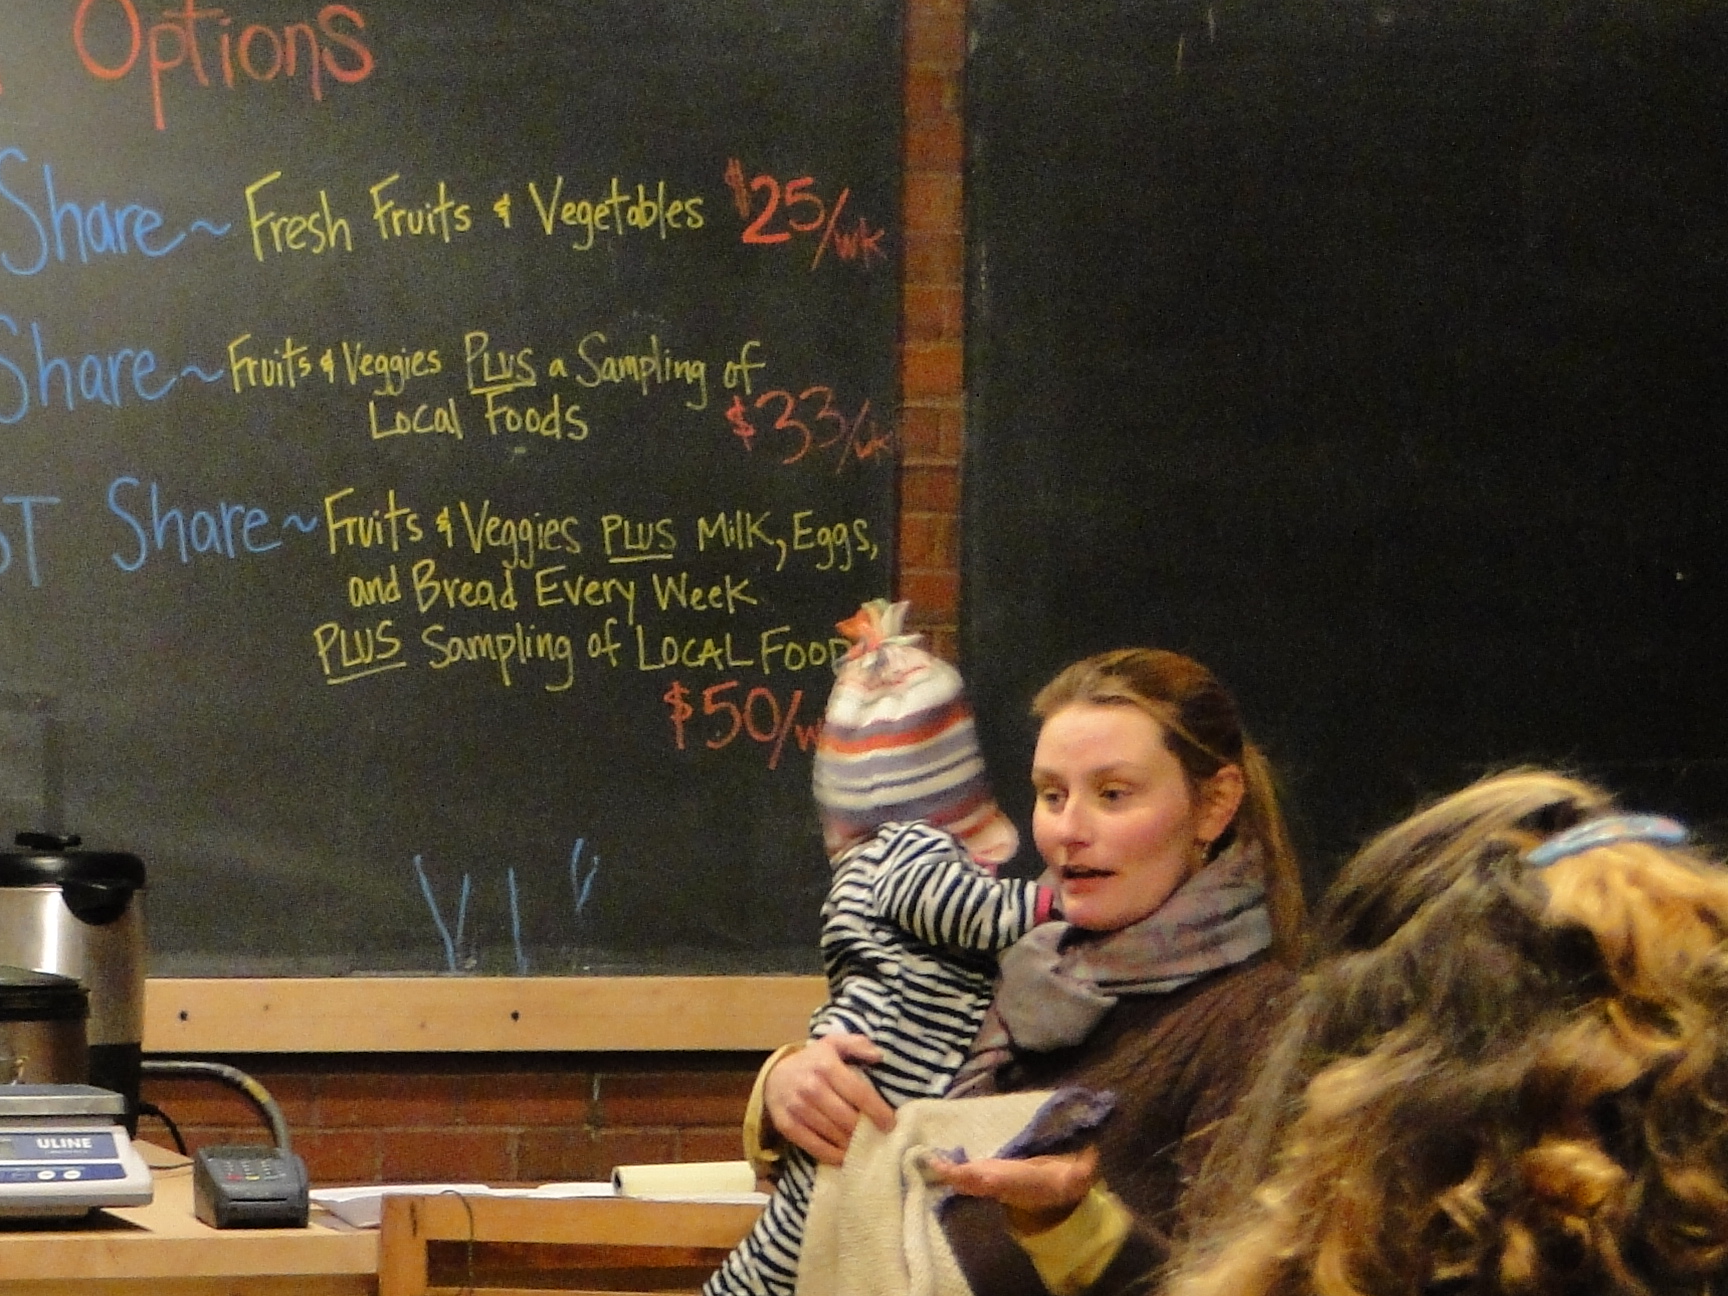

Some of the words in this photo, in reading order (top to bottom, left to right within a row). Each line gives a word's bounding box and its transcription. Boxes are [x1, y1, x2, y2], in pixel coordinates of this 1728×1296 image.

[73, 0, 373, 131] Options
[245, 170, 353, 261] Fresh
[370, 174, 472, 242] Fruits
[528, 176, 704, 250] Vegetables
[228, 334, 311, 393] Fruits
[342, 342, 442, 396] Veggies
[465, 331, 536, 384] PLUS
[549, 358, 568, 380] a
[577, 331, 708, 410] Sampling
[723, 340, 767, 395] of
[369, 400, 463, 440] Local
[484, 390, 589, 440] Foods
[324, 487, 423, 554] Fruits
[459, 500, 579, 569] Veggies
[602, 515, 676, 551] PLUS
[349, 566, 400, 610] and
[412, 560, 516, 613] Bread
[535, 565, 635, 625] Every
[652, 572, 757, 614] Week
[313, 620, 403, 676] PLUS
[421, 622, 573, 692] Sampling
[588, 618, 620, 667] of
[36, 1137, 92, 1149] ULINE
